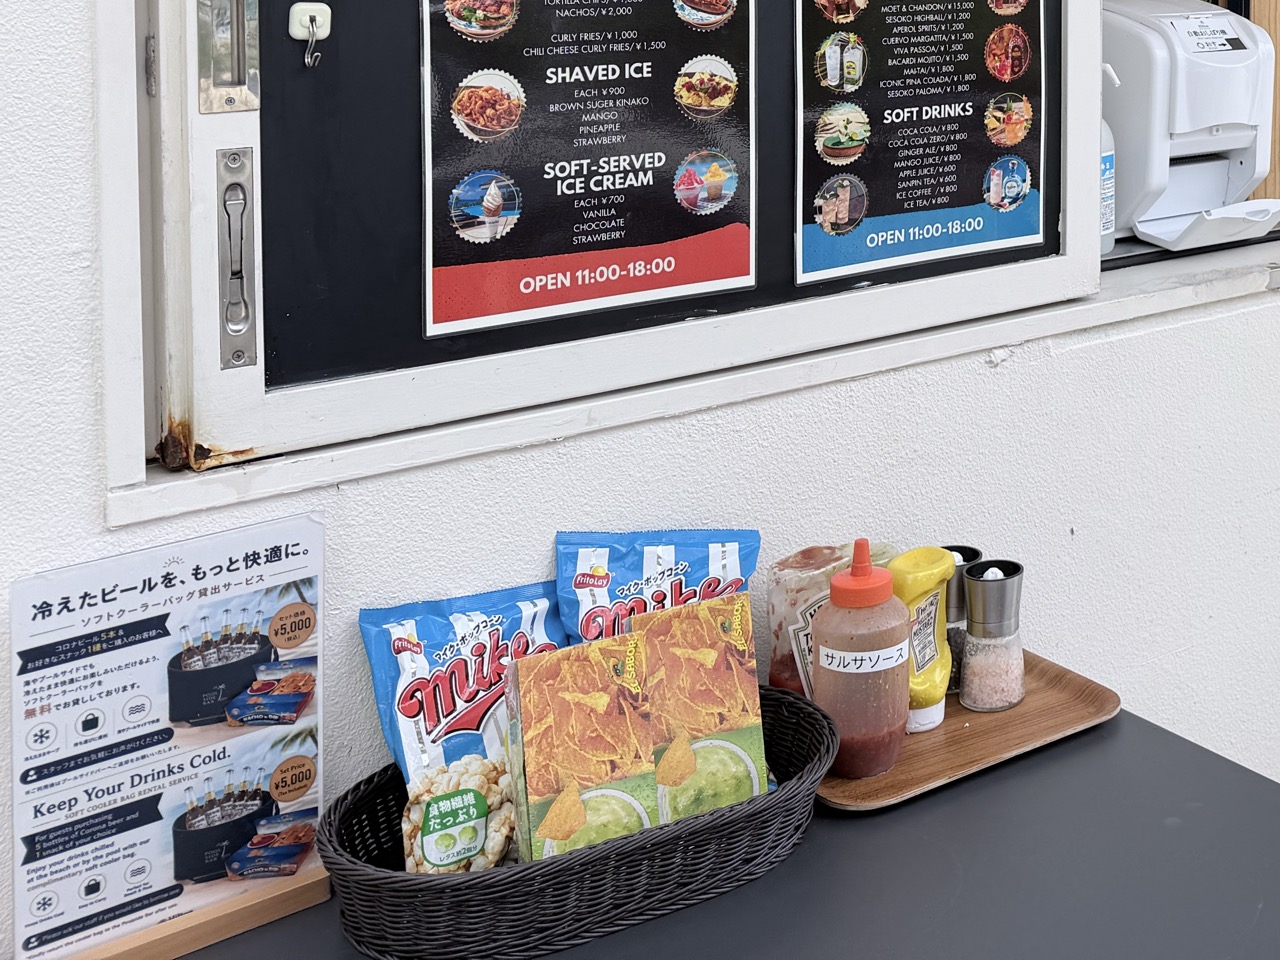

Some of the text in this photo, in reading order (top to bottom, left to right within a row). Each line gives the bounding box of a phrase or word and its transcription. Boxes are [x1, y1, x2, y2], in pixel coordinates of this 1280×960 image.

[885, 15, 913, 23] SESOKO
[892, 25, 917, 33] APEROL
[550, 32, 577, 42] CURLY
[893, 47, 909, 55] VIVA
[887, 57, 916, 66] BACARDI
[545, 63, 652, 84] SHAVED ICE
[879, 79, 904, 88] ICONIC
[905, 77, 922, 86] PINA
[574, 87, 625, 97] EACH ¥900
[887, 89, 915, 98] SESOKO
[549, 97, 649, 112] BROWN SUGER KINAKO
[581, 111, 618, 121] MANGO
[882, 102, 973, 124] SOFT DRINKS
[579, 123, 620, 133] PINEAPPLE
[897, 127, 918, 136] COCA
[573, 135, 626, 146] STRAWBERRY
[897, 147, 924, 157] GINGER
[543, 152, 666, 178] SOFT-SERVED
[556, 170, 653, 195] ICE CREAM
[897, 179, 922, 189] SANPIN
[574, 195, 625, 206] EACH ¥700
[903, 200, 914, 208] ICE
[582, 208, 616, 218] VANILLA
[573, 219, 625, 231] CHOCOLATE
[866, 217, 983, 247] OPEN 11:00-18:00
[572, 230, 626, 244] STRAWBERRY
[519, 257, 675, 293] OPEN 11:00-18:00
[31, 542, 310, 622] 冷えたビールを、もっと快適に。
[617, 562, 689, 596] マイク・ポップコーン
[81, 574, 265, 628] ソフトクーラーバッグ貸出サービス
[733, 598, 745, 636] SABOR
[274, 617, 311, 637] ¥5,000
[434, 615, 502, 662] マイク・ポップコーン
[626, 639, 638, 679] SABOR
[824, 647, 905, 670] サルサソース
[24, 680, 103, 707] ソフトクーラーバッグを
[280, 763, 306, 775] Set Price
[32, 746, 231, 819] Keep Your Drinks Cold.
[275, 769, 311, 791] ¥5,000
[64, 772, 199, 820] SOFT COOLER BAG RENTAL SERVICE
[429, 792, 476, 818] 食物繊維
[429, 806, 477, 831] たっぷり
